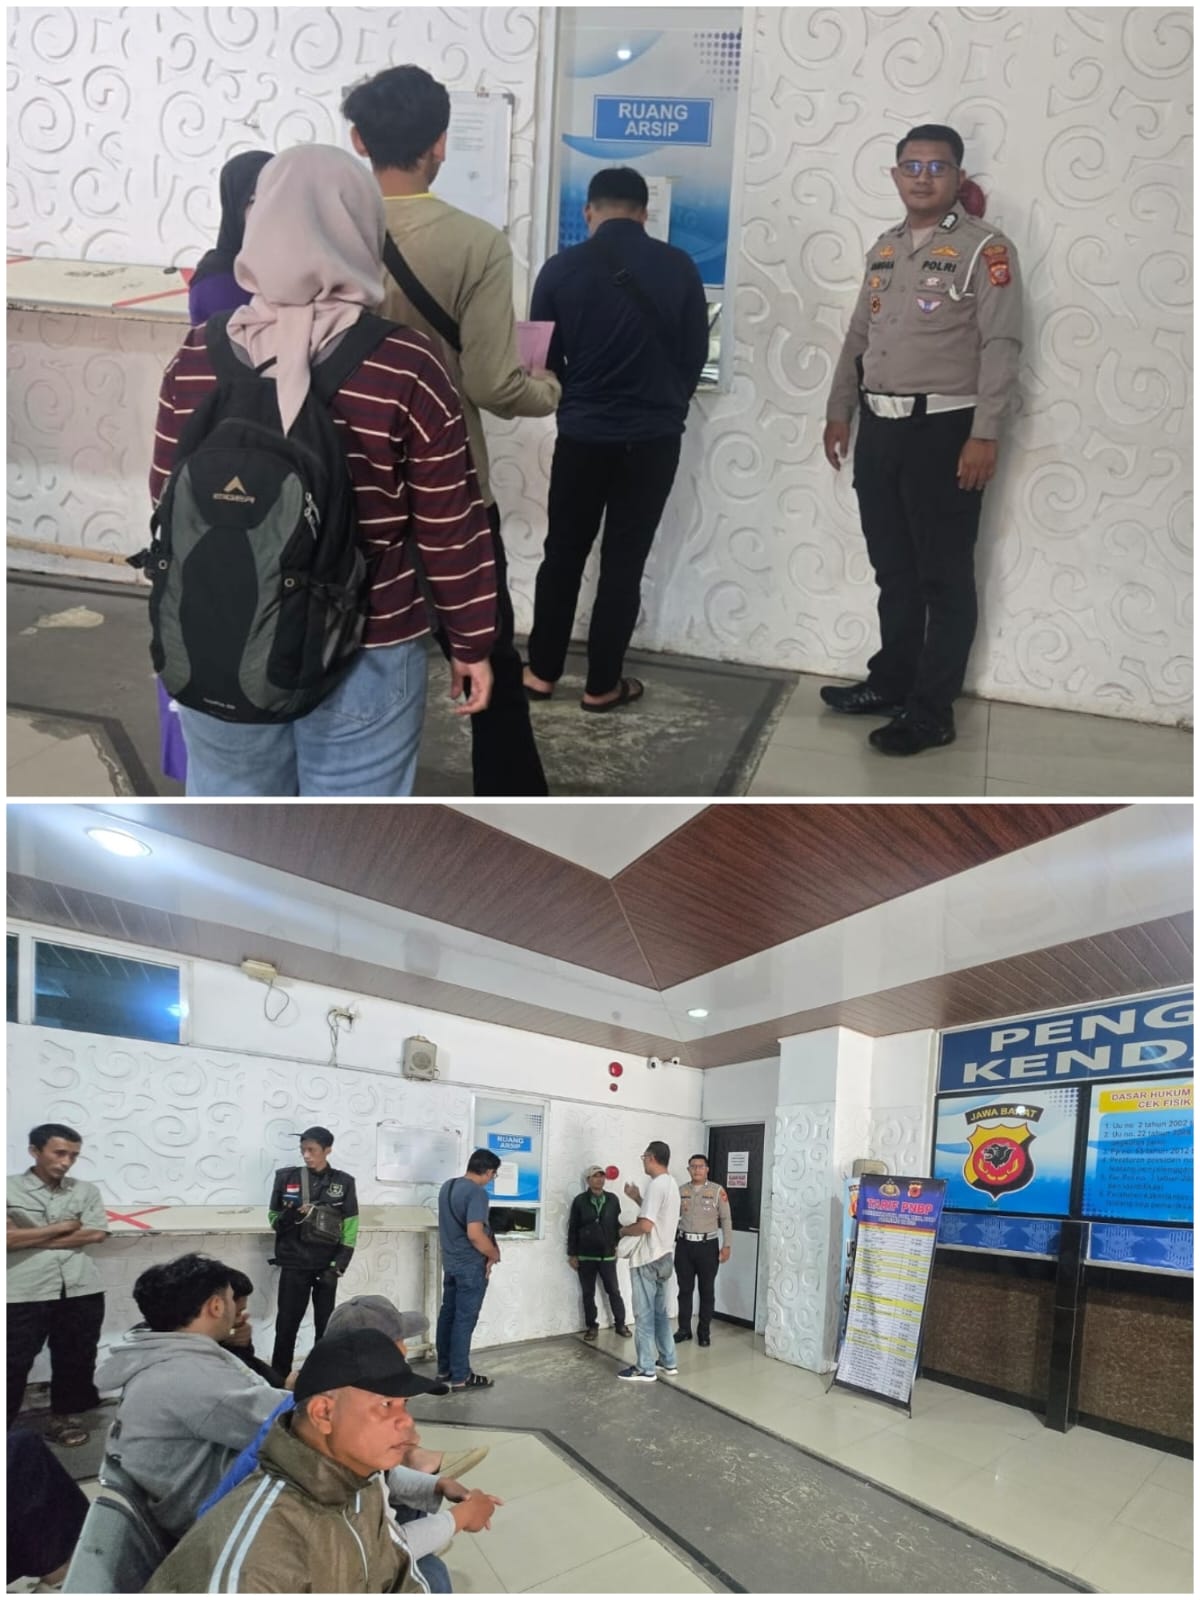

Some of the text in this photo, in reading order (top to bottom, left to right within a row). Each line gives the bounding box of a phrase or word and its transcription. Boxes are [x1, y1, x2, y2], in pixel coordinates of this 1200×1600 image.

[618, 102, 688, 120] RUANG
[625, 121, 679, 137] ARSIP
[921, 260, 957, 273] POLRI
[990, 1000, 1194, 1053] PENG
[963, 1039, 1194, 1084] KEND
[1111, 1088, 1191, 1101] DASAR HUKUM
[1138, 1098, 1191, 1108] CEK FISIK
[971, 1107, 998, 1121] JAWA
[497, 1135, 524, 1144] RUANG
[866, 1198, 933, 1215] TARIF PNBP
